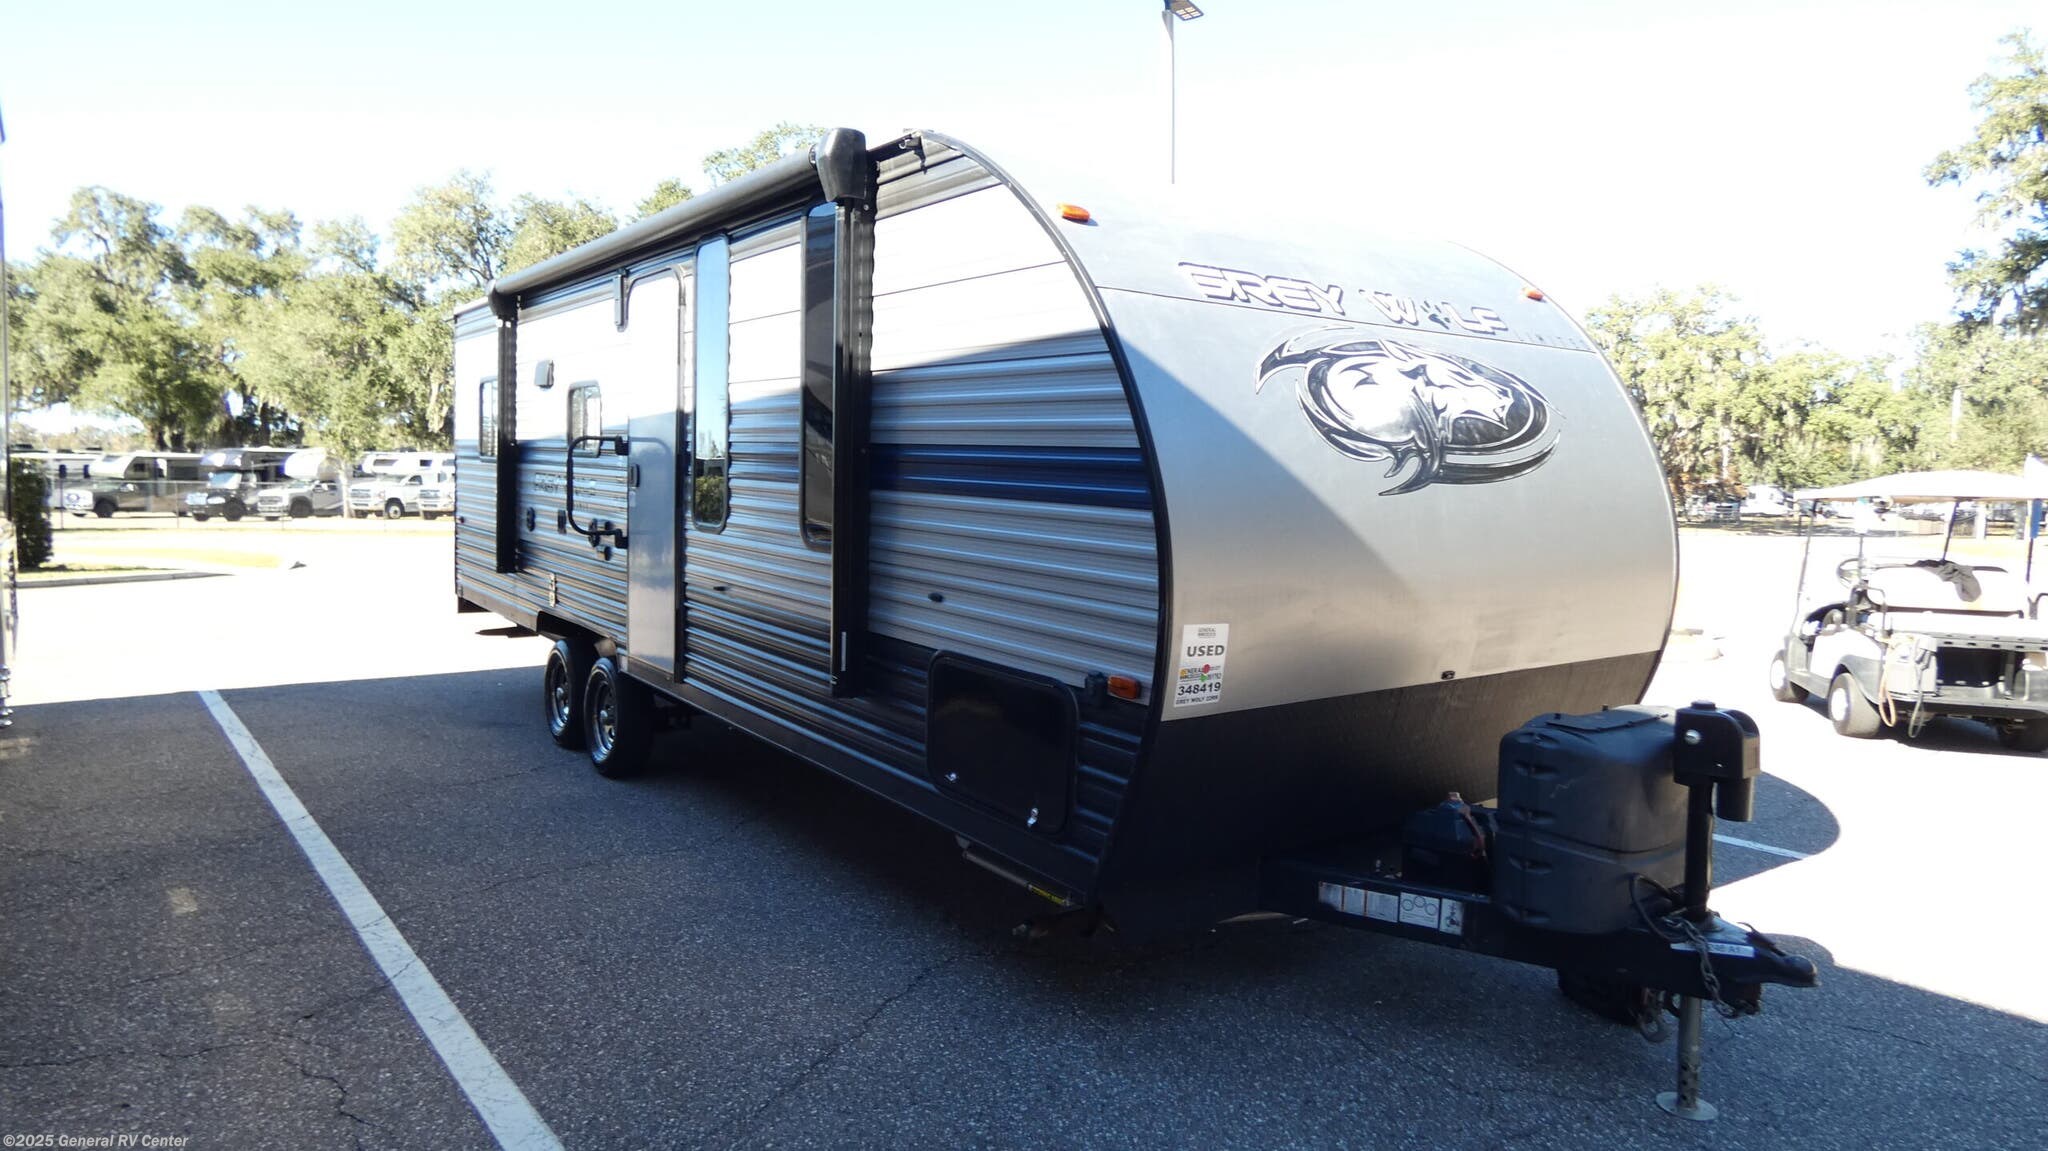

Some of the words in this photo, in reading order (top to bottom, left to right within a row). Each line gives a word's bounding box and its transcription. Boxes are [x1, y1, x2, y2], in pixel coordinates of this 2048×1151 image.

[1178, 261, 1345, 316] GREY
[1187, 646, 1225, 657] USED
[1178, 682, 1221, 696] 348419
